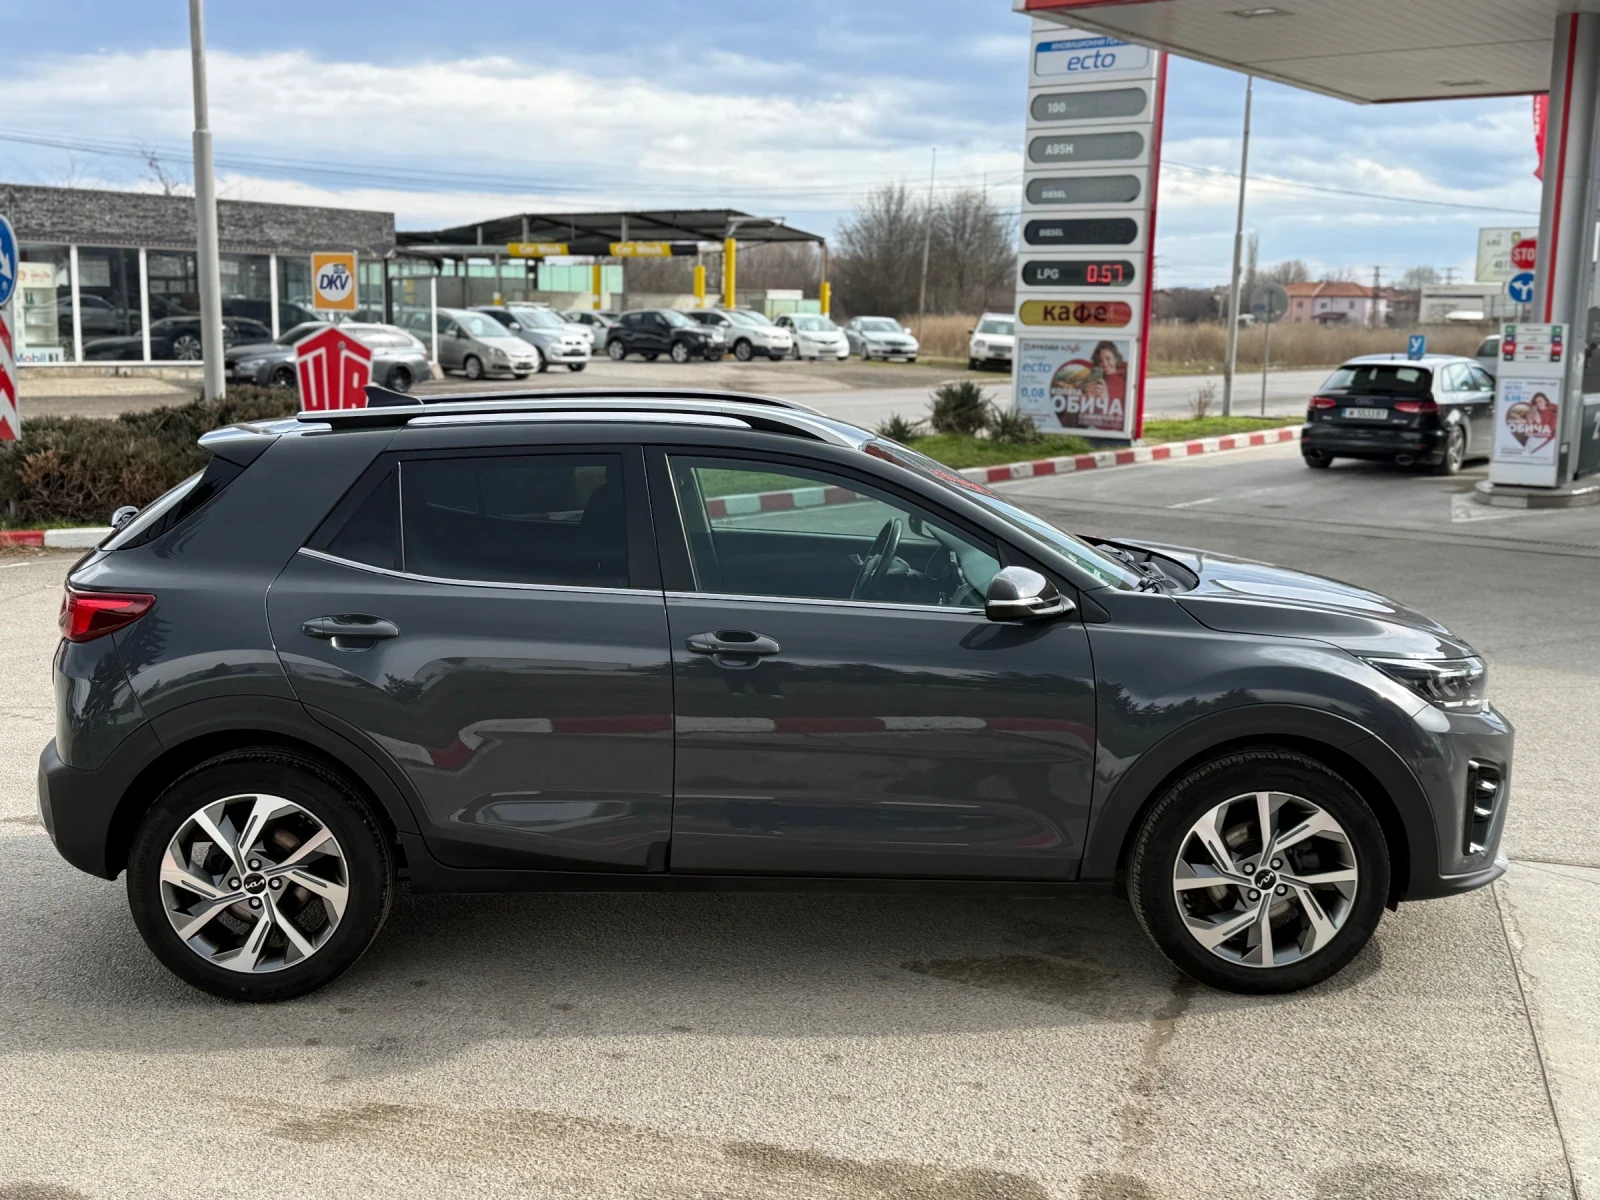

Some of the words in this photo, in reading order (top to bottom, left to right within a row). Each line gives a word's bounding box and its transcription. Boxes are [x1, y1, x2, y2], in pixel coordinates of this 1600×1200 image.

[1067, 50, 1116, 71] ecto
[1048, 103, 1066, 113] 100
[1513, 247, 1536, 261] STO
[1037, 269, 1060, 279] LPG
[1086, 265, 1123, 283] 0.57
[319, 274, 349, 291] DKV
[1043, 304, 1107, 323] кафе
[15, 353, 46, 363] Mobil
[1022, 362, 1052, 373] ecto
[1051, 395, 1123, 416] ОБИЧА
[1509, 423, 1552, 435] ОБИЧА
